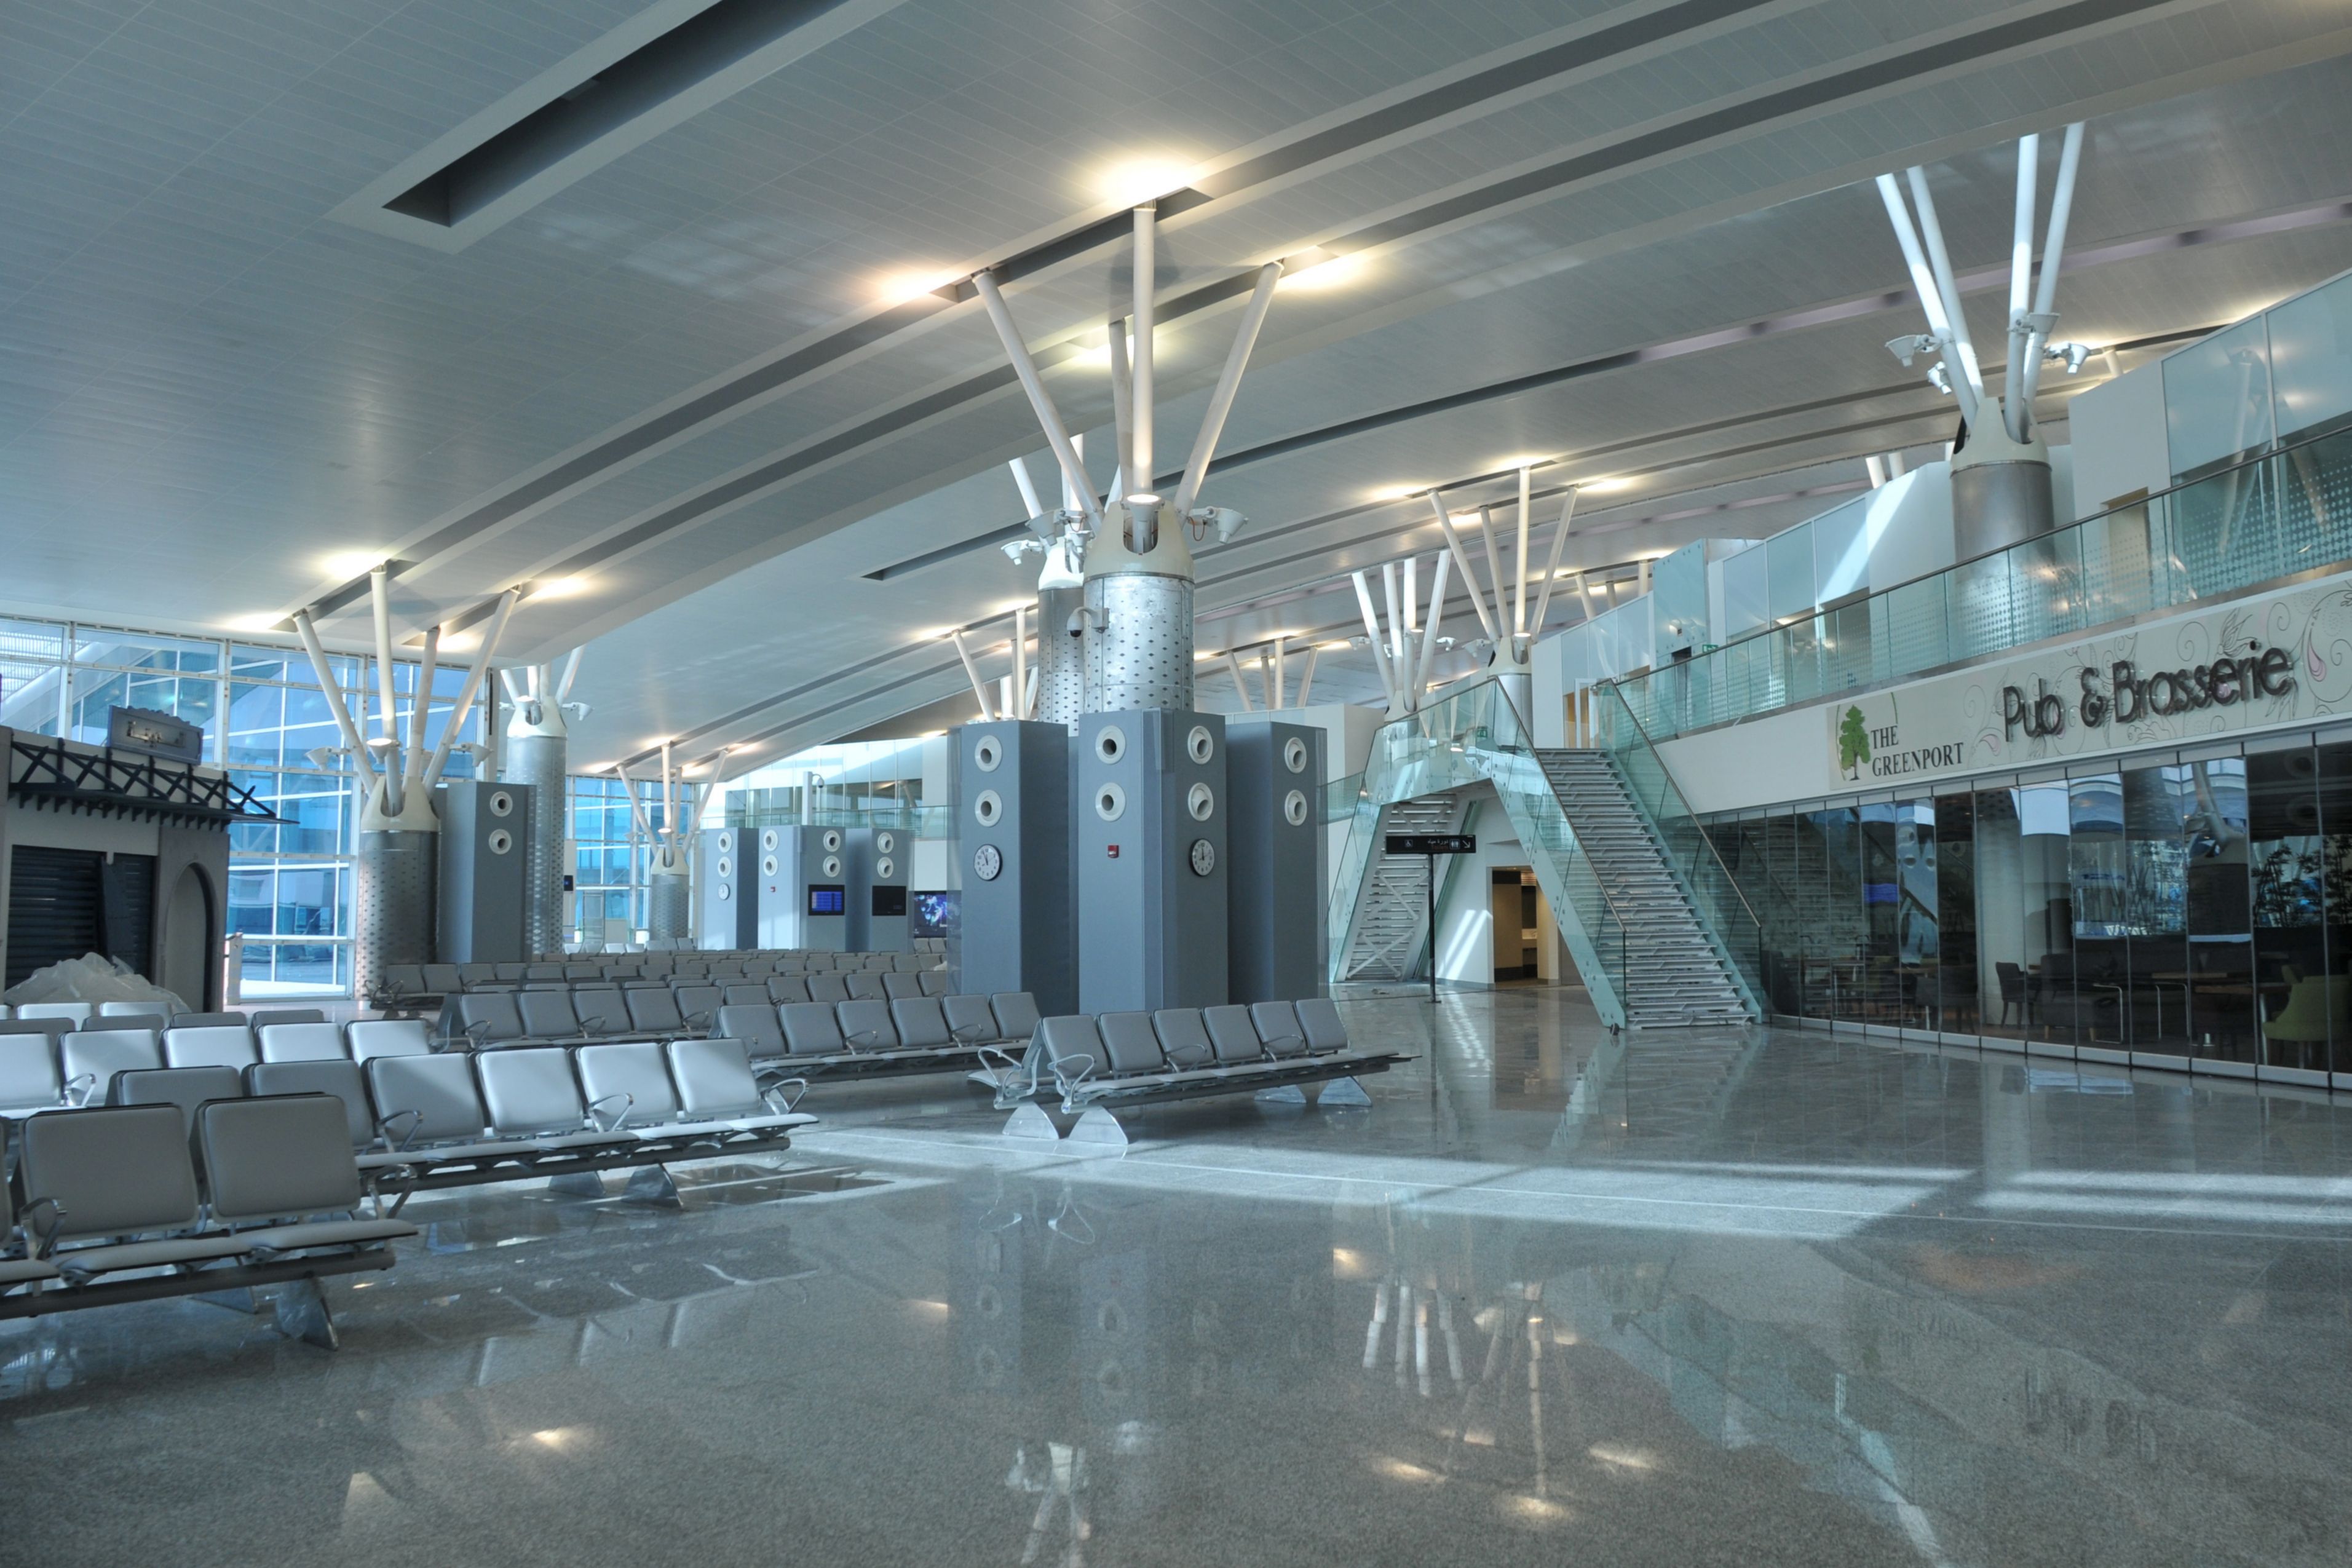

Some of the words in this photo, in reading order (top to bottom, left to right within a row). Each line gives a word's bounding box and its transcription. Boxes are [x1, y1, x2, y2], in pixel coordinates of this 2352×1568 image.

[2003, 678, 2064, 742] Pub
[2080, 667, 2107, 727] &
[2112, 639, 2294, 723] Brasserie
[1871, 726, 1899, 750] THE
[1872, 742, 1964, 777] GREENPORT
